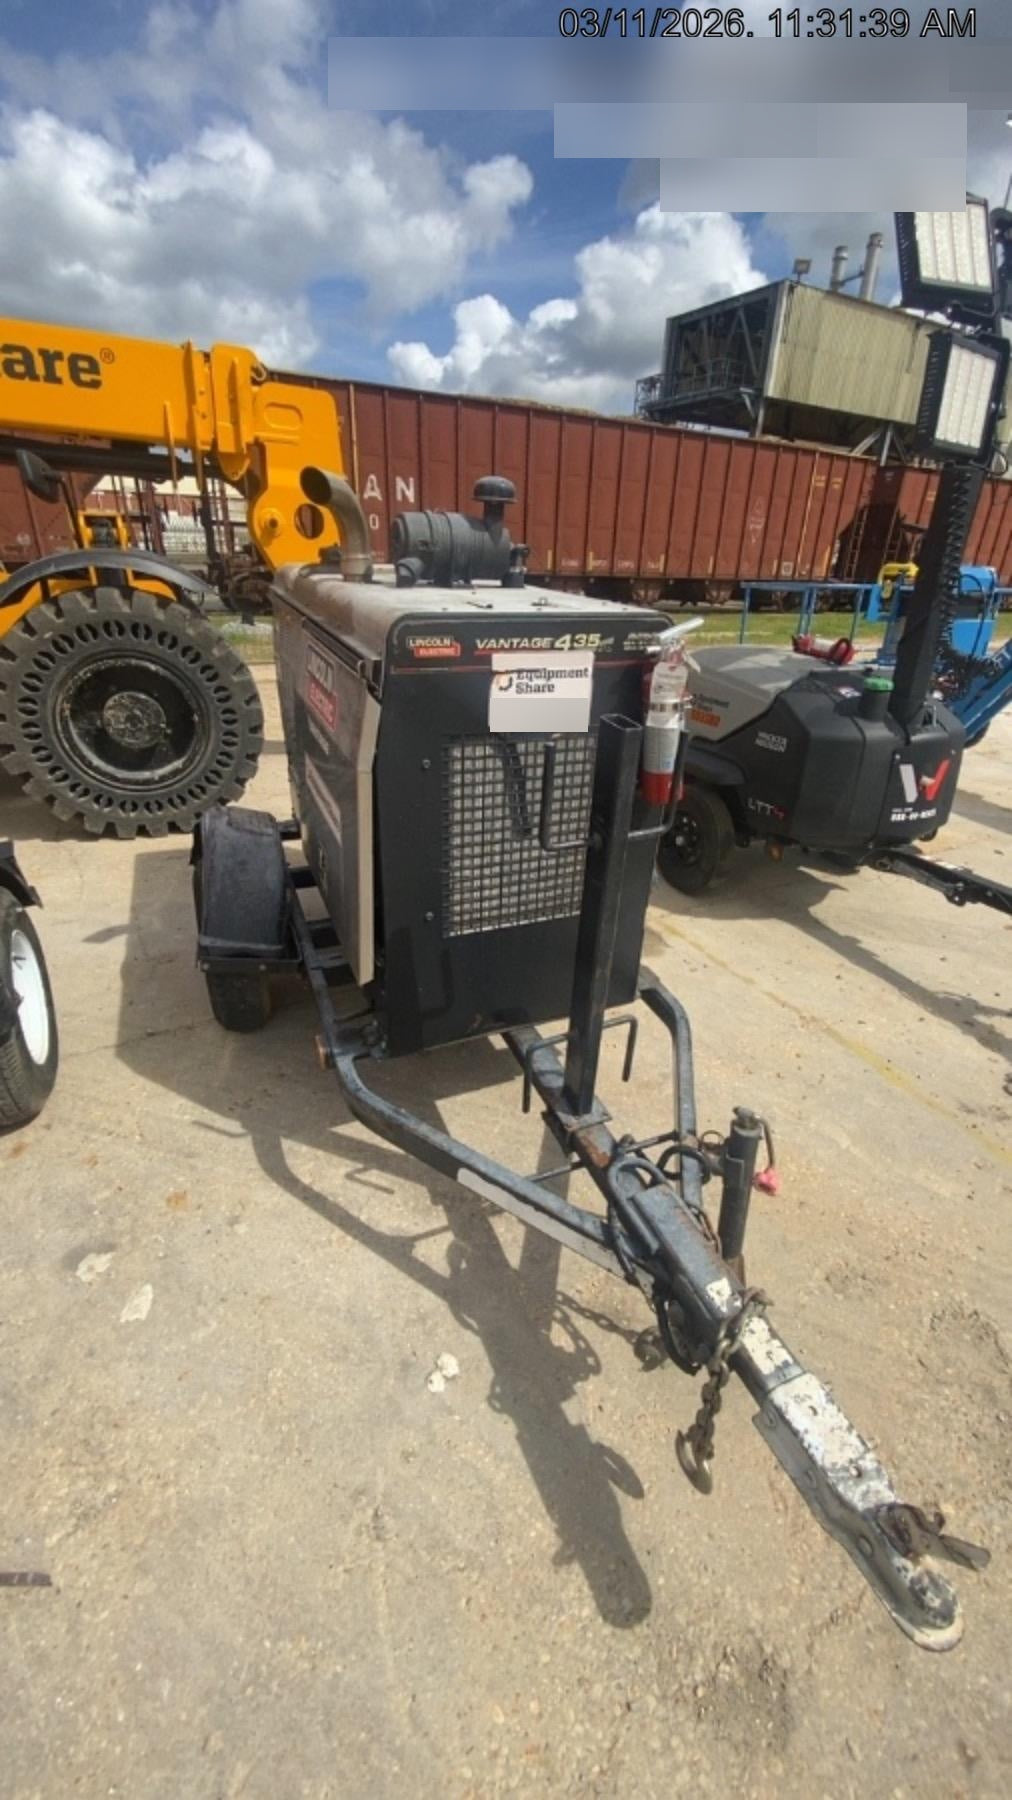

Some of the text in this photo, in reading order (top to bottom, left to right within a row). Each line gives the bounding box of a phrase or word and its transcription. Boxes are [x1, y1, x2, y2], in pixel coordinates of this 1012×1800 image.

[409, 638, 451, 648] LINCOLN
[475, 633, 601, 651] VANTAGE 435
[515, 667, 589, 681] Equipment
[515, 682, 555, 695] Share
